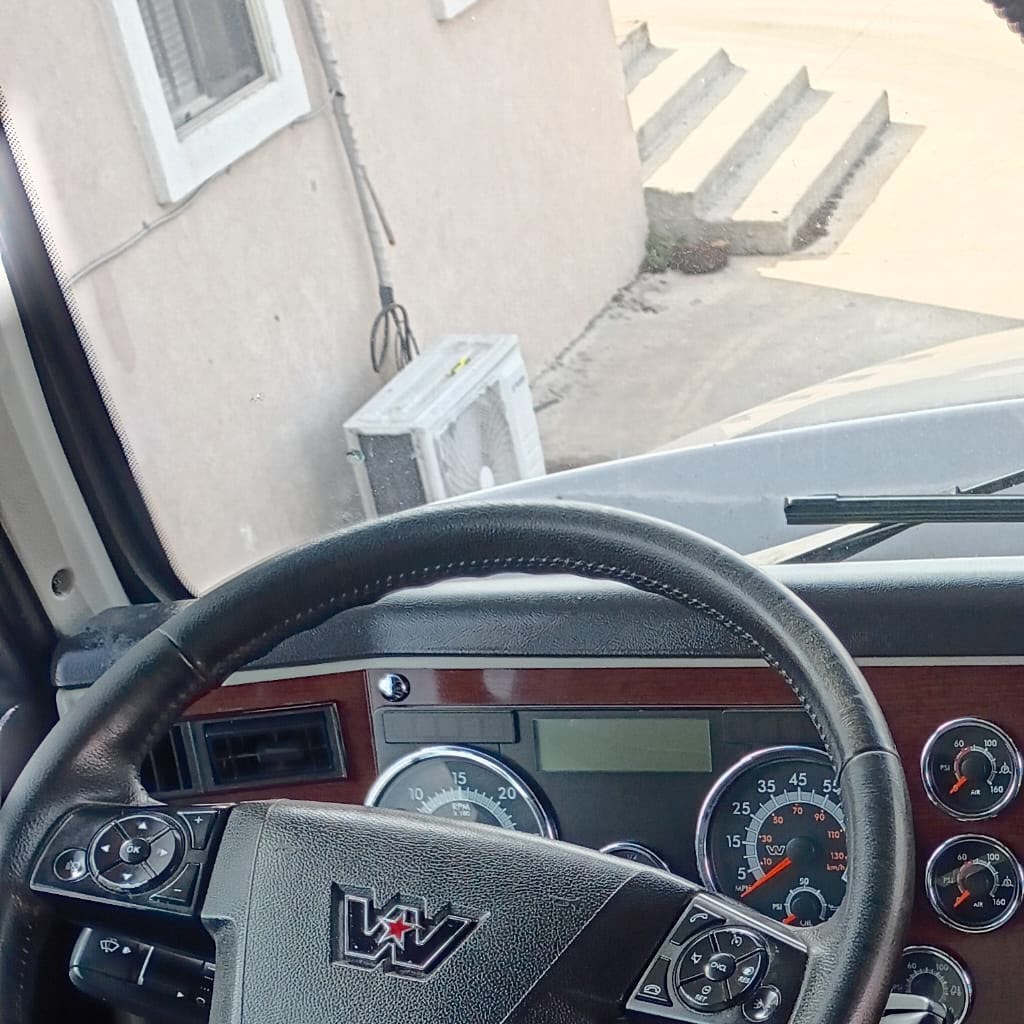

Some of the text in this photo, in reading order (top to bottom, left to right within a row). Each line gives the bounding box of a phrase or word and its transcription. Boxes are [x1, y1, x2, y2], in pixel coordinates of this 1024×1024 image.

[954, 740, 965, 748] 60
[983, 740, 998, 748] 100
[452, 771, 468, 785] 15
[789, 773, 807, 786] 45
[757, 780, 776, 793] 35
[990, 785, 1004, 794] 160
[408, 788, 424, 800] 10
[498, 787, 517, 800] 20
[452, 802, 471, 811] RPM
[732, 802, 751, 815] 25
[793, 807, 803, 815] 70
[772, 816, 784, 825] 50
[814, 813, 825, 822] 90
[761, 835, 773, 843] 30
[827, 831, 840, 839] 110
[726, 835, 741, 848] 15
[127, 845, 141, 854] OK
[831, 852, 845, 860] 130
[957, 853, 968, 861] 60
[986, 853, 1000, 862] 100
[826, 863, 846, 872] km/h
[737, 868, 747, 880] 5
[799, 877, 809, 885] 50
[993, 897, 1006, 906] 160
[935, 963, 949, 971] 100
